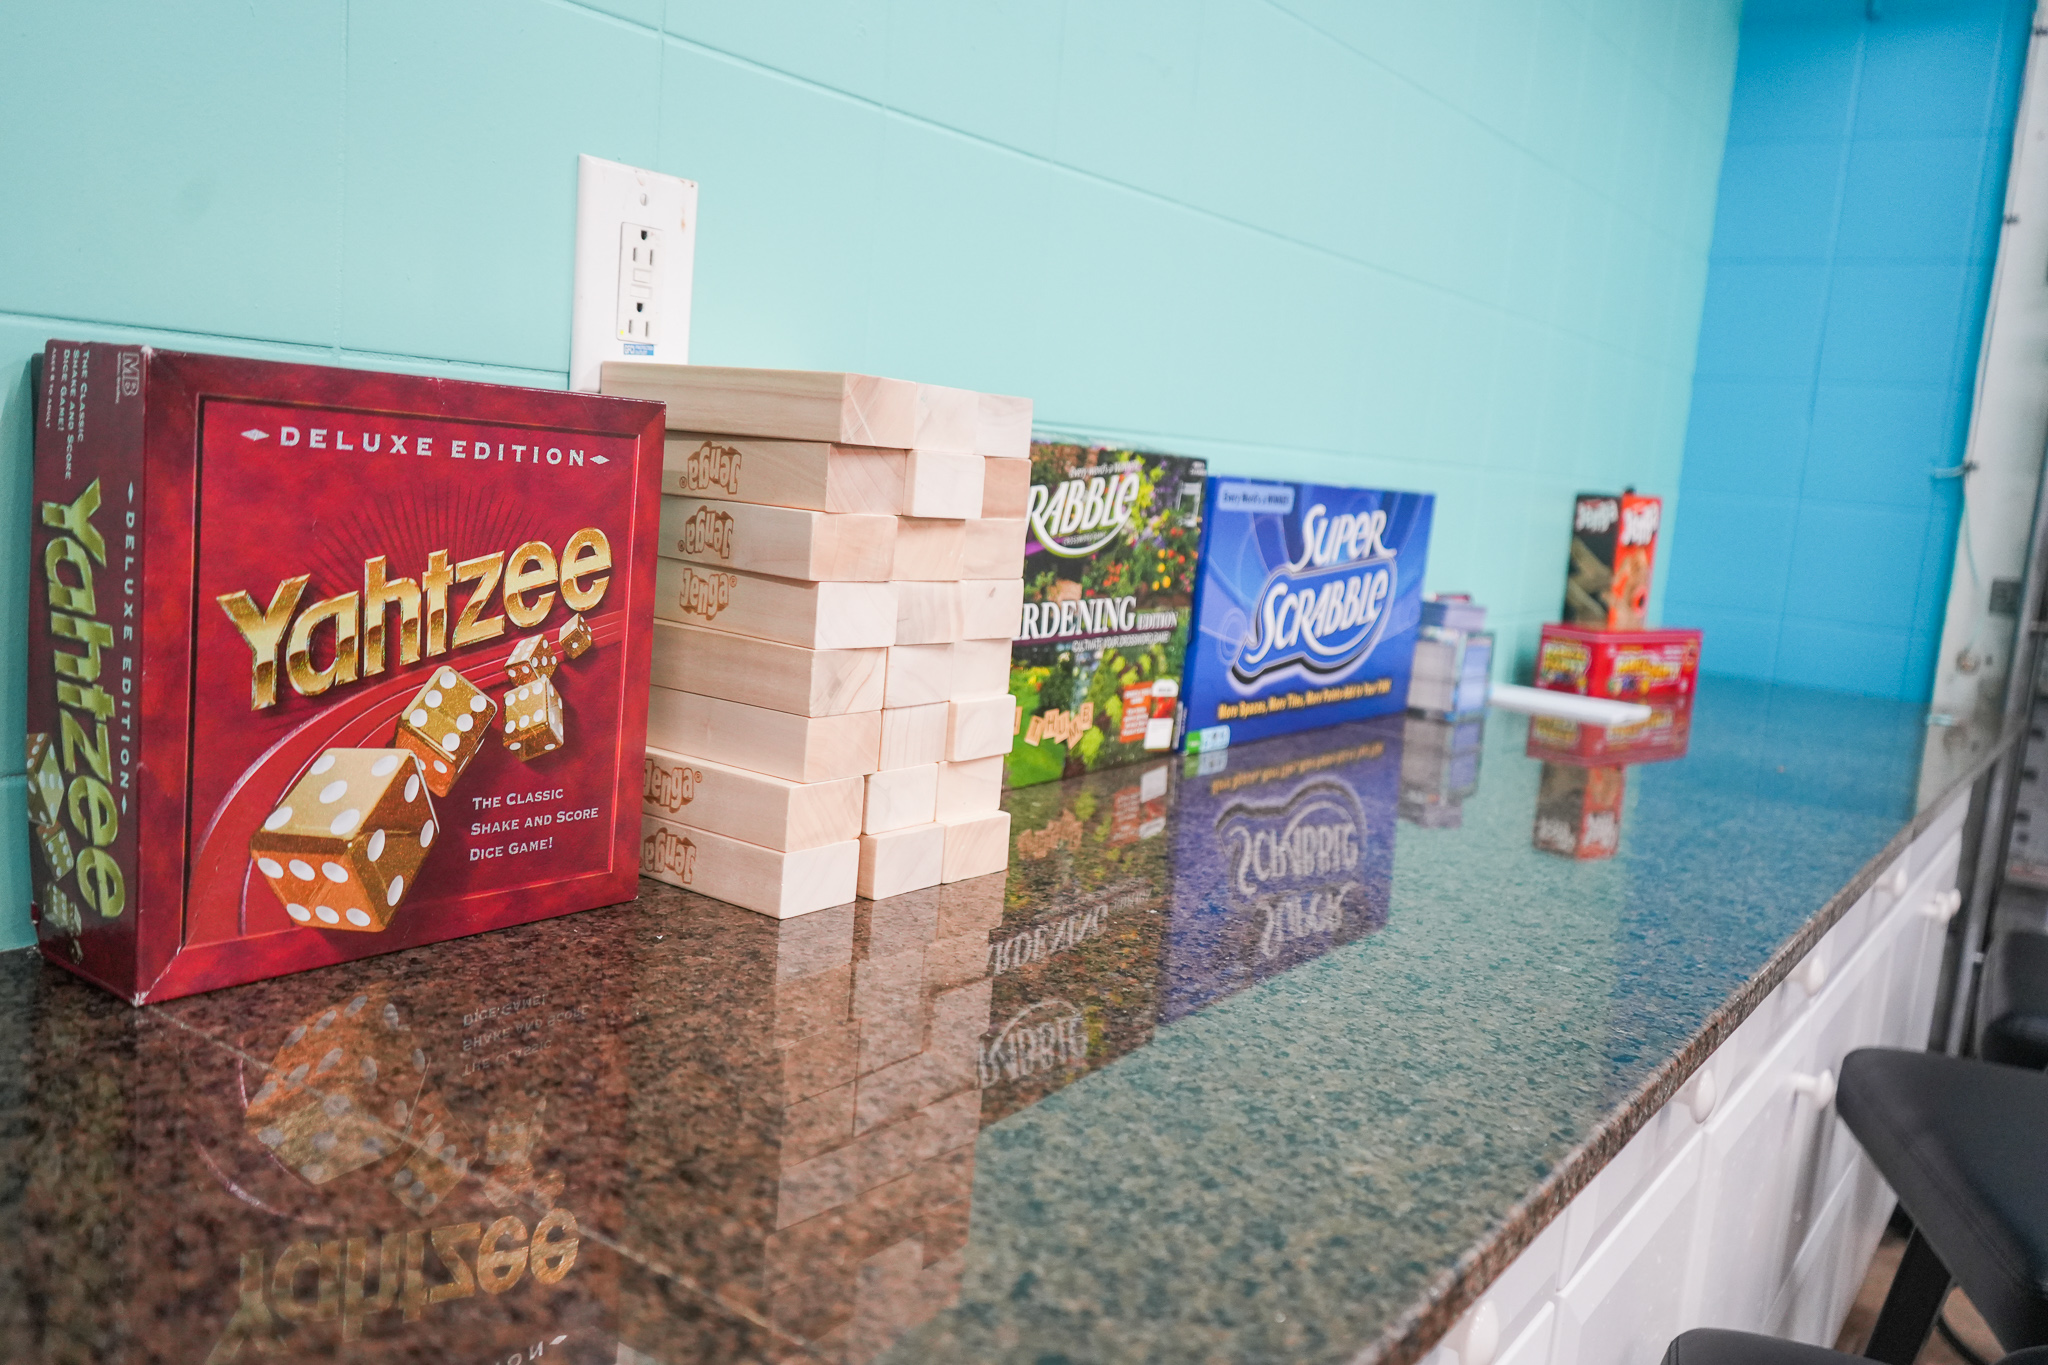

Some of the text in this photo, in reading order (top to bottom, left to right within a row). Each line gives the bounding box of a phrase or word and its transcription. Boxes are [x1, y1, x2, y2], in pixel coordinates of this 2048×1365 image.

[62, 349, 70, 381] DICE
[70, 349, 80, 397] SHAKE
[123, 352, 140, 396] MB
[78, 382, 88, 443] CLASSIC
[65, 434, 74, 480] SCORE
[279, 425, 585, 467] DELUXE EDITION
[687, 441, 742, 495] Jenga
[684, 505, 734, 559] Jenga
[1288, 503, 1397, 573] SUPER
[216, 526, 613, 711] Yahtzee
[679, 568, 730, 621] Jenga
[1013, 595, 1137, 641] RDENING
[1244, 569, 1389, 664] SCRABBLE
[119, 510, 135, 789] DELUXE EDITION
[42, 476, 125, 918] Yahtzee
[1217, 703, 1239, 721] More
[472, 788, 564, 811] THE CLASSIC
[643, 759, 694, 813] Jenga
[470, 807, 599, 836] SHAKE AND SCORE
[469, 836, 554, 861] DICE GAME!
[643, 827, 697, 885] Jenga
